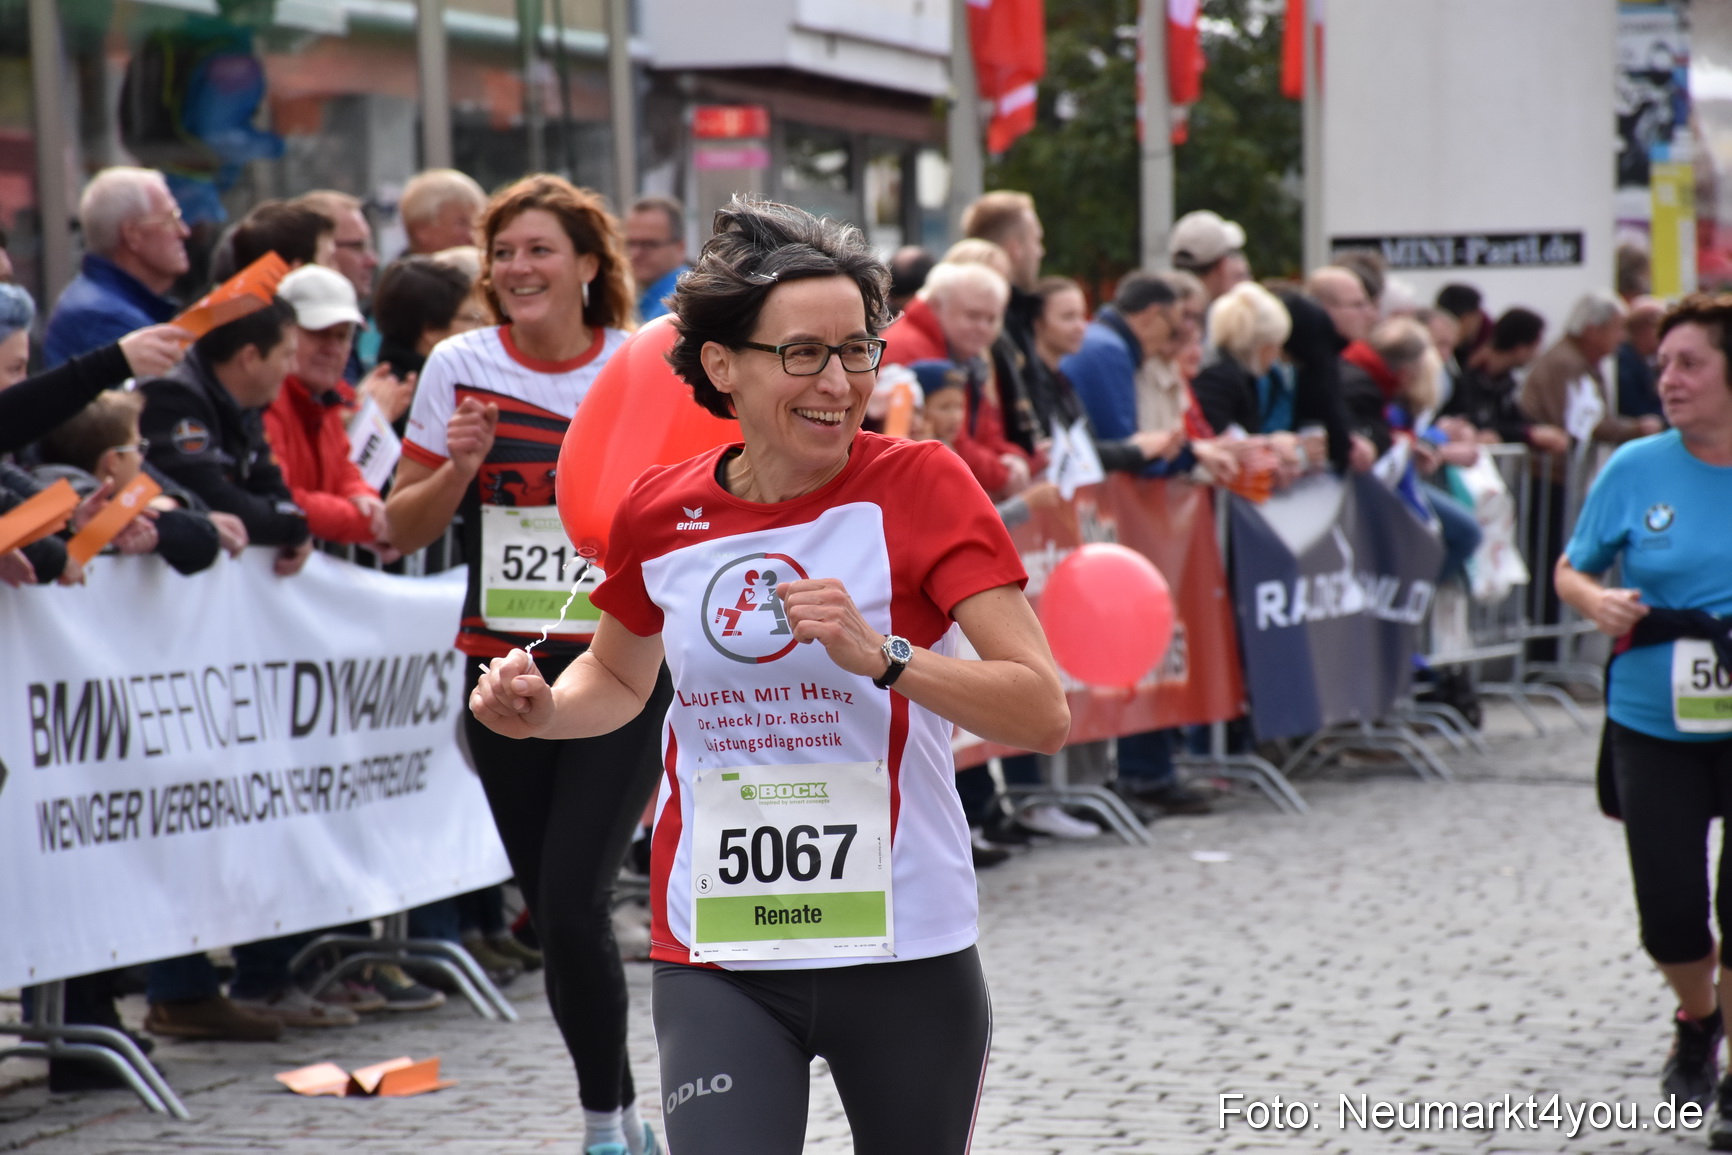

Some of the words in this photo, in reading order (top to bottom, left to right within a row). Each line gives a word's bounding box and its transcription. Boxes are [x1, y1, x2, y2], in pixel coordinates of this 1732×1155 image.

[676, 521, 710, 530] erima
[677, 690, 745, 707] LAUFEN
[755, 687, 791, 702] MIT
[801, 683, 854, 705] HERZ
[28, 678, 130, 768] BMW
[698, 718, 715, 730] Dr.
[717, 713, 752, 728] Heck
[756, 713, 761, 727] /
[765, 713, 786, 726] Dr.
[790, 711, 839, 724] Röschl
[759, 782, 829, 799] BOCK
[35, 790, 143, 854] WENIGER
[719, 824, 857, 885] 5067
[701, 879, 708, 890] S
[755, 904, 822, 925] Renate
[666, 1073, 733, 1115] ODLO
